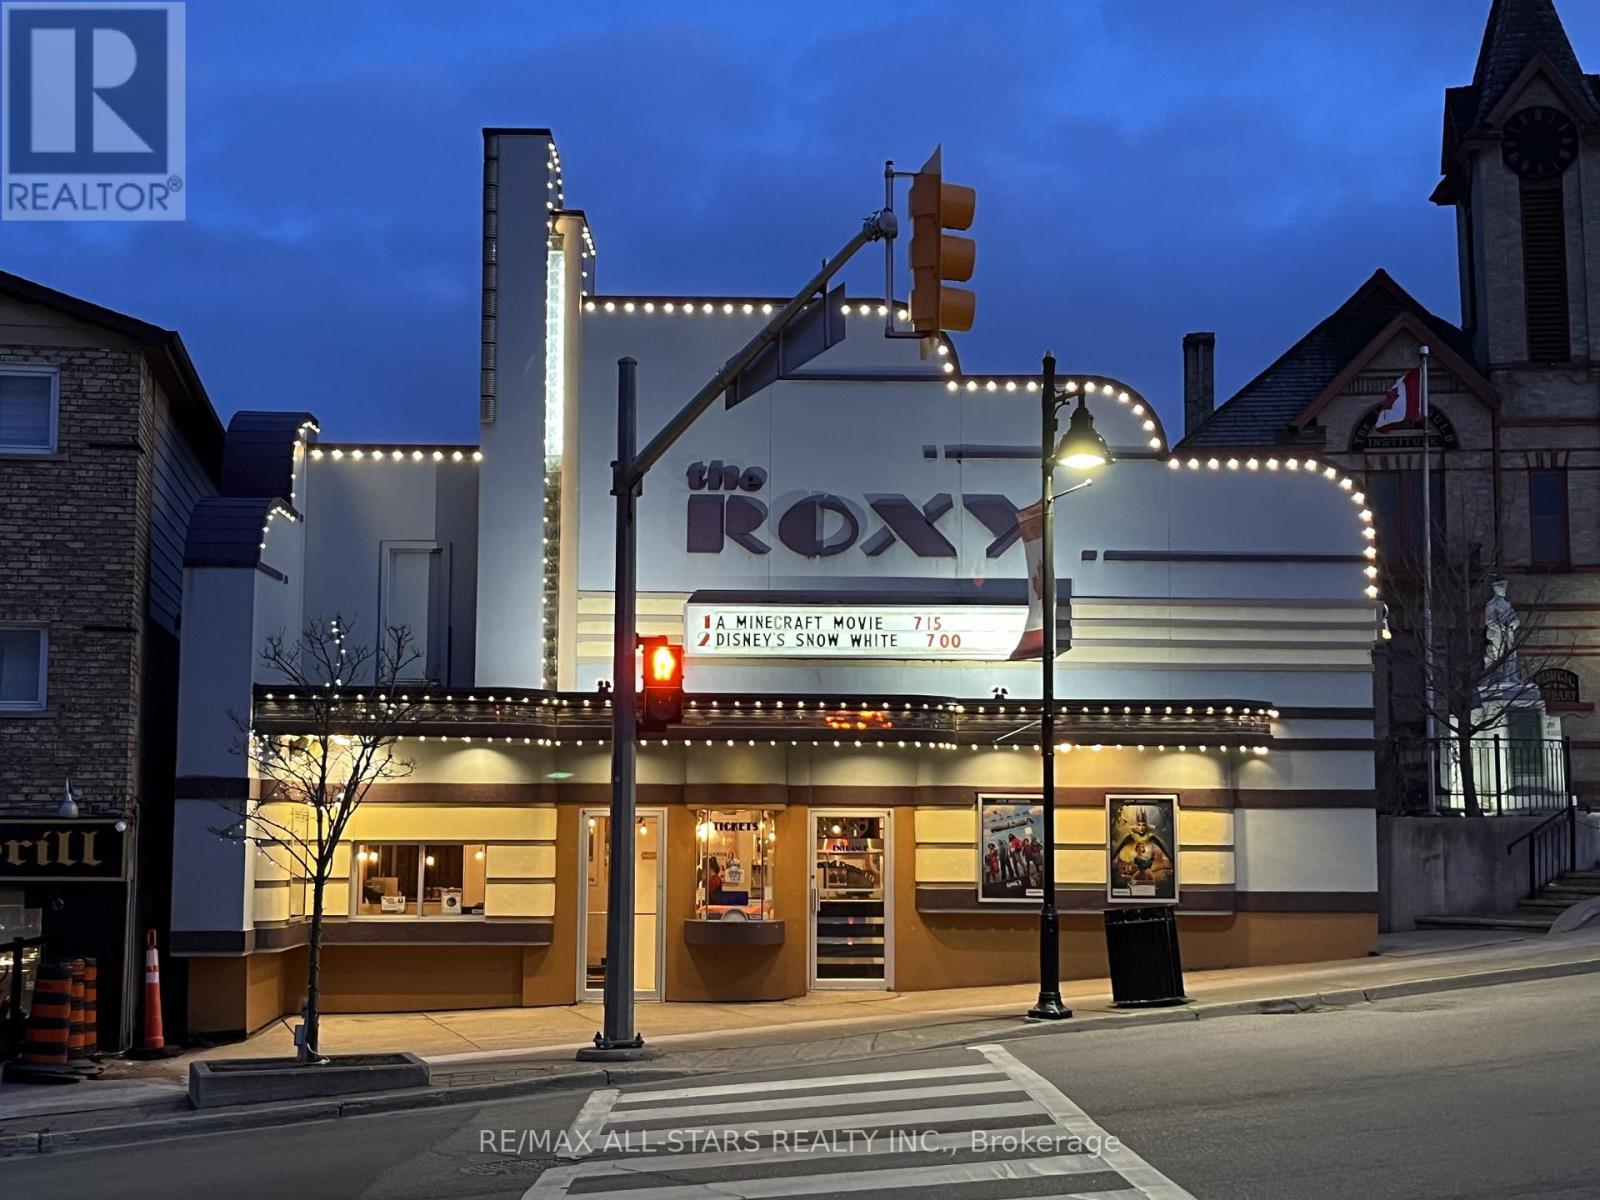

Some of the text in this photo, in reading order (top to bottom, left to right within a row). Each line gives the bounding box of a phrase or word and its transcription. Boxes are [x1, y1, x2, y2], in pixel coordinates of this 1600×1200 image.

[686, 460, 768, 492] the
[686, 493, 1024, 560] ROXY
[716, 616, 725, 630] A
[737, 616, 823, 630] MINECRAFT
[833, 616, 883, 630] MOVIE
[716, 633, 785, 647] DISNEY'S
[796, 633, 838, 647] SNOW
[851, 633, 898, 647] WHITE
[927, 634, 961, 648] 700
[713, 821, 759, 832] TICKETS
[0, 831, 104, 866] rill
